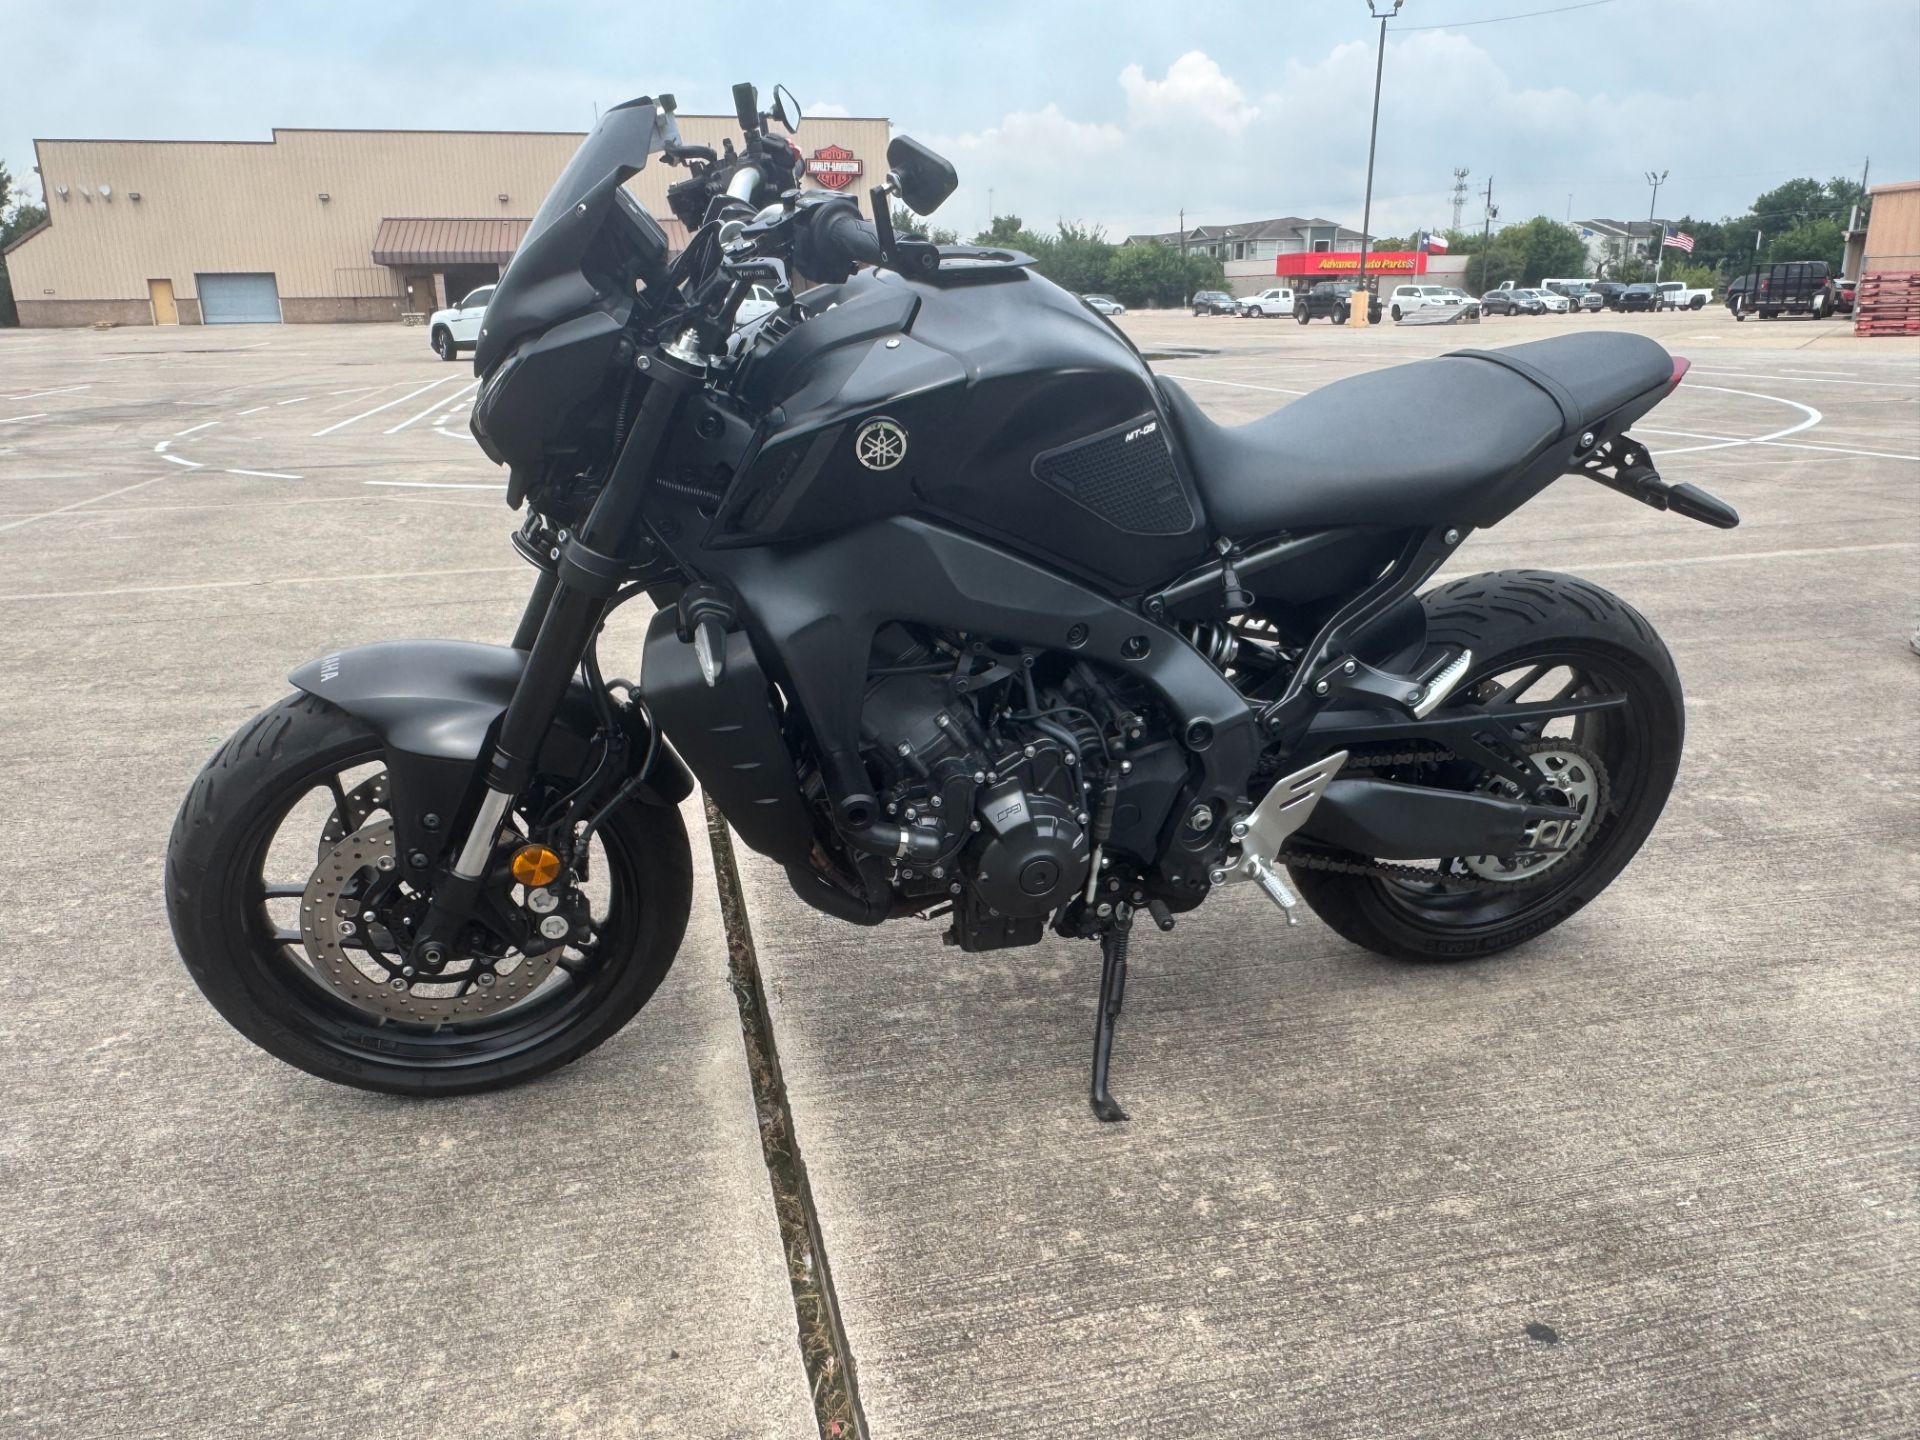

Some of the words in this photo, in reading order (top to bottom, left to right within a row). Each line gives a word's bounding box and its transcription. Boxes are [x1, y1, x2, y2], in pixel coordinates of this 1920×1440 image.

[1318, 258, 1358, 270] Advance
[1358, 259, 1382, 270] uto
[1382, 259, 1407, 270] Parts
